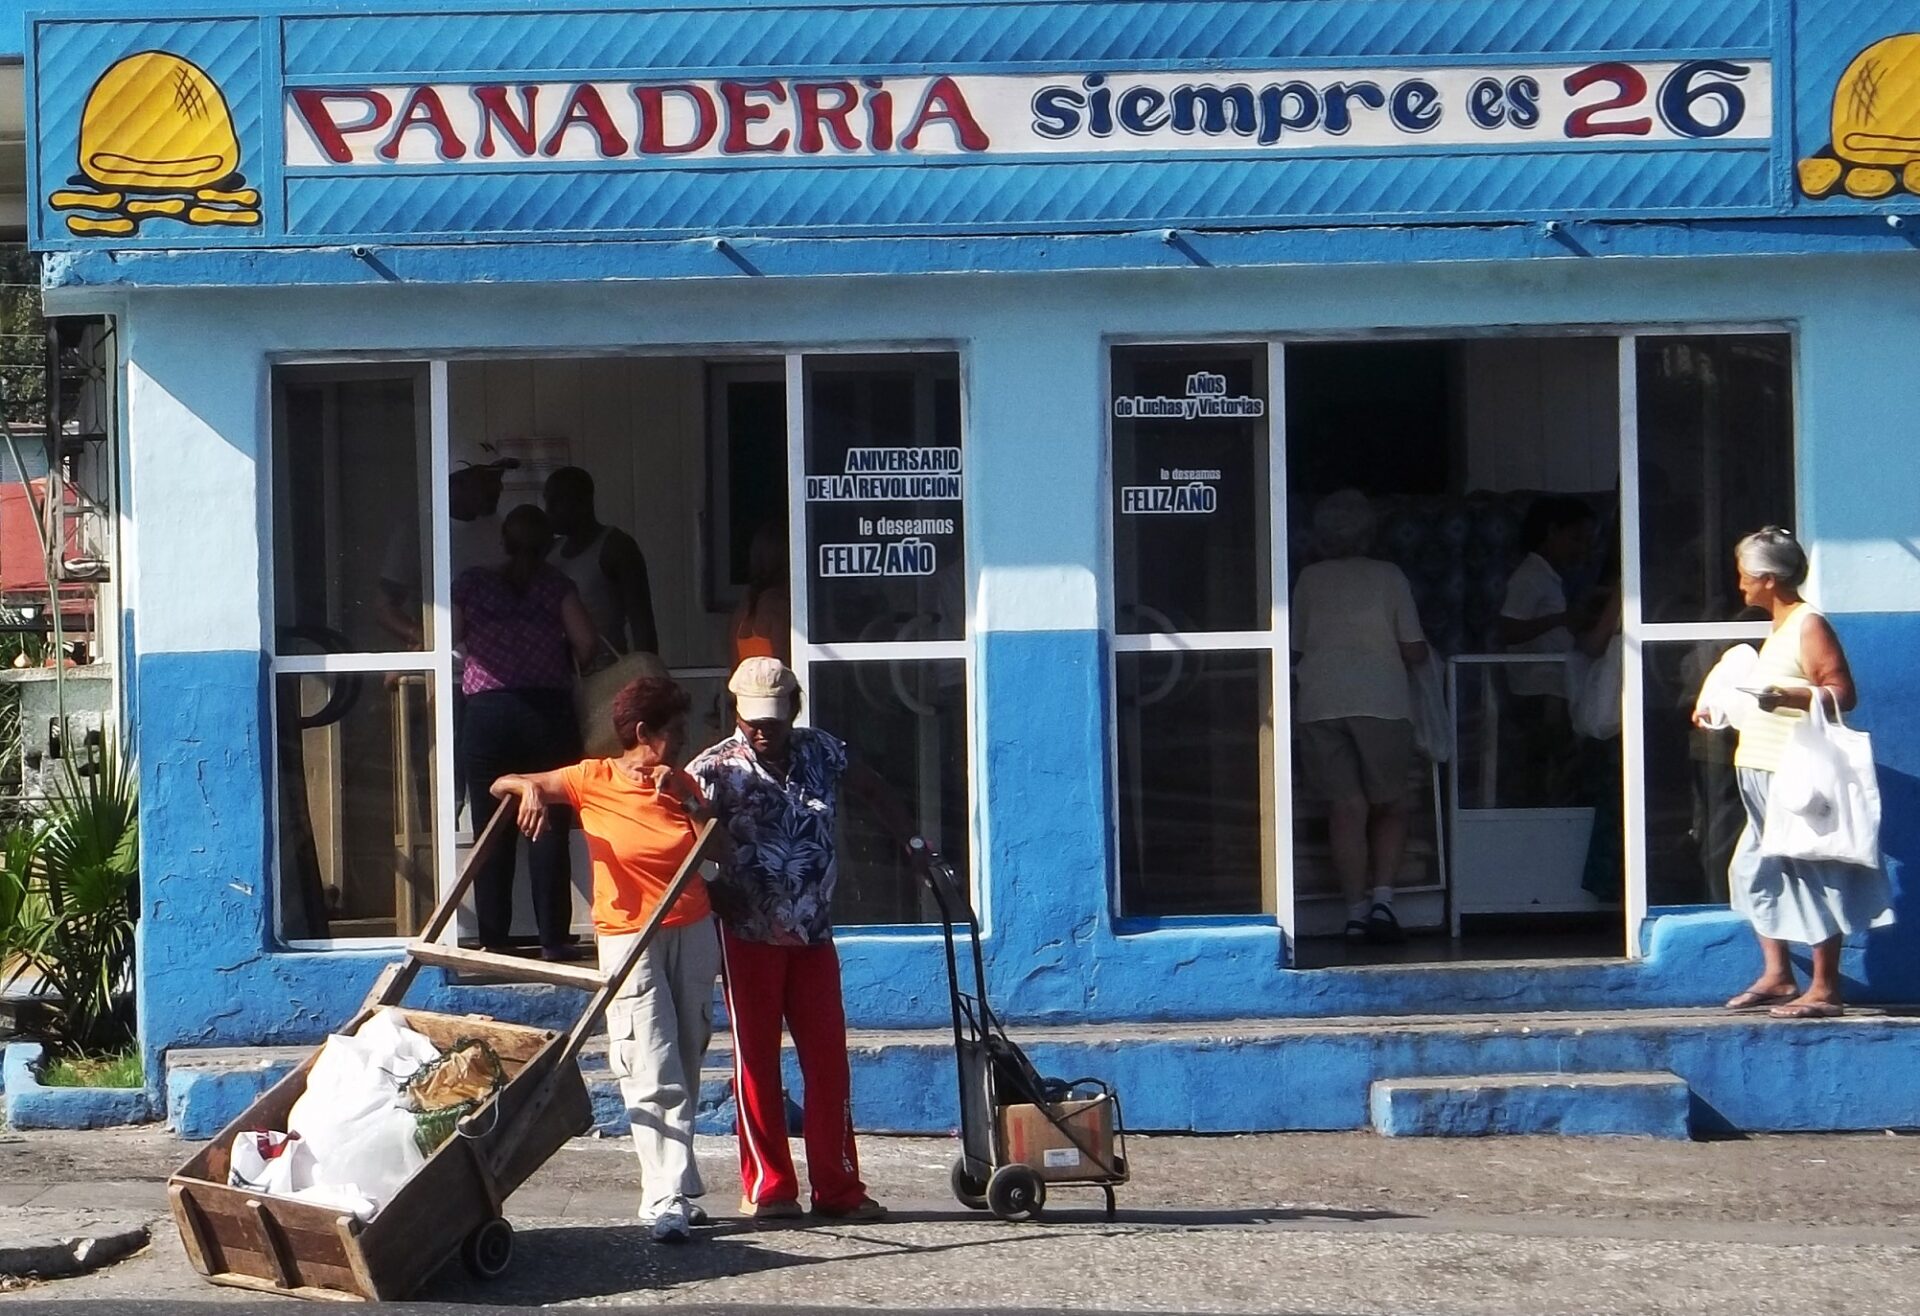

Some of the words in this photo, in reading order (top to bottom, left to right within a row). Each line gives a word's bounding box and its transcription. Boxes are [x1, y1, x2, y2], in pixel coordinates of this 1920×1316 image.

[1030, 71, 1444, 145] siempre
[1466, 74, 1540, 131] es
[1562, 60, 1751, 140] 26
[1186, 372, 1226, 396] AÑOS
[1115, 397, 1133, 417] de
[1134, 396, 1184, 417] Luchas
[1184, 400, 1197, 419] y
[1197, 396, 1264, 417] Victorias
[845, 447, 961, 473] ANIVERSARIO
[1172, 467, 1221, 480] deseamos
[805, 475, 830, 501] DE
[831, 475, 857, 500] LA
[1122, 487, 1172, 513] FELIZ
[1173, 482, 1216, 513] AÑO
[859, 517, 873, 536] le
[877, 516, 954, 535] deseamos
[819, 543, 881, 577] FELIZ
[883, 538, 936, 576] AÑO
